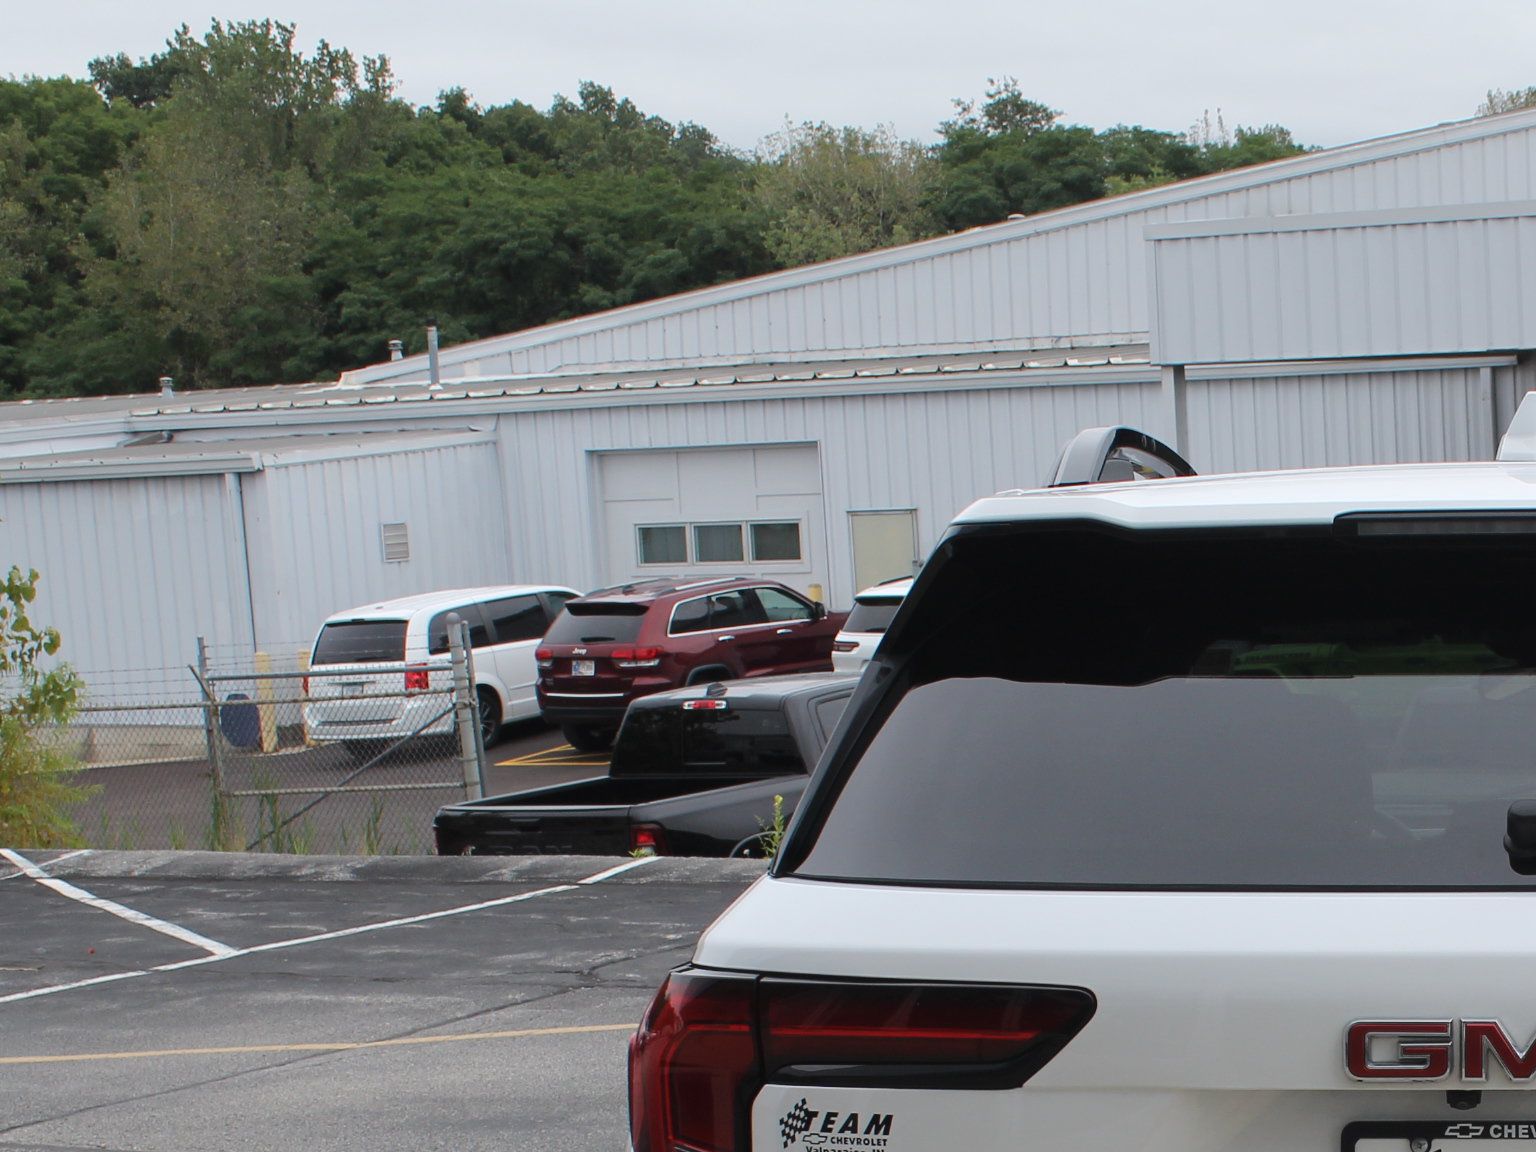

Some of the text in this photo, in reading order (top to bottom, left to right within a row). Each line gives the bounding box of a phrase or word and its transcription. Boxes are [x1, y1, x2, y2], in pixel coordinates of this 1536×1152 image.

[572, 647, 587, 655] Jeep
[802, 1110, 893, 1136] TEAM
[830, 1136, 888, 1147] CHEVROLET
